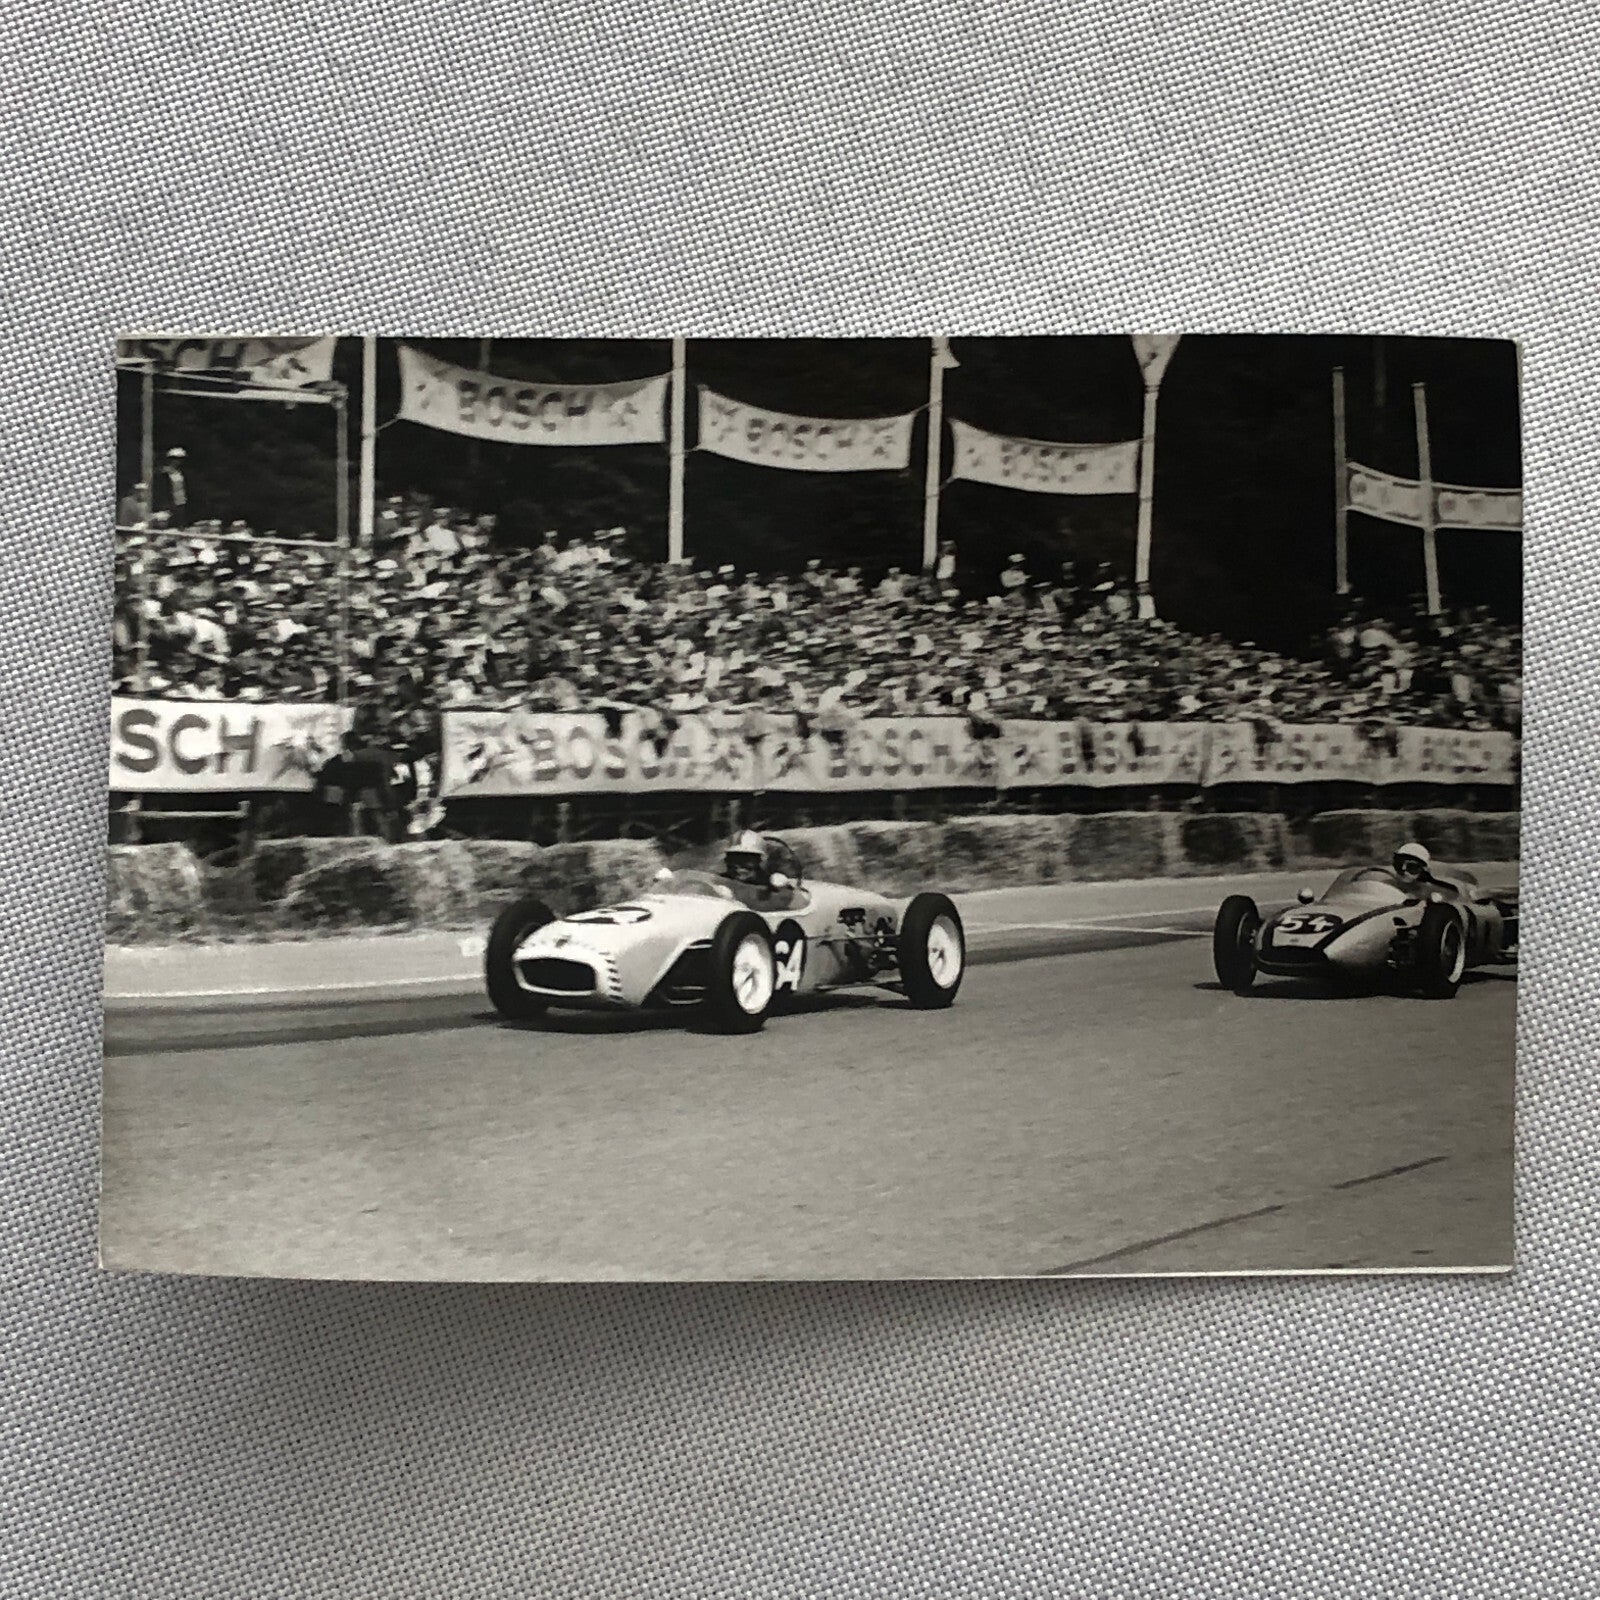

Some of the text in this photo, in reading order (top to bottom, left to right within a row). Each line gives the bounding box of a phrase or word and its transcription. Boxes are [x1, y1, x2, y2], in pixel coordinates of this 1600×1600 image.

[458, 379, 596, 432] BOSCH
[748, 417, 860, 460] BOSCH
[1001, 443, 1095, 484] BOSCH
[117, 708, 263, 774] SCH
[1058, 731, 1166, 775] BSCH
[1276, 914, 1334, 932] 54
